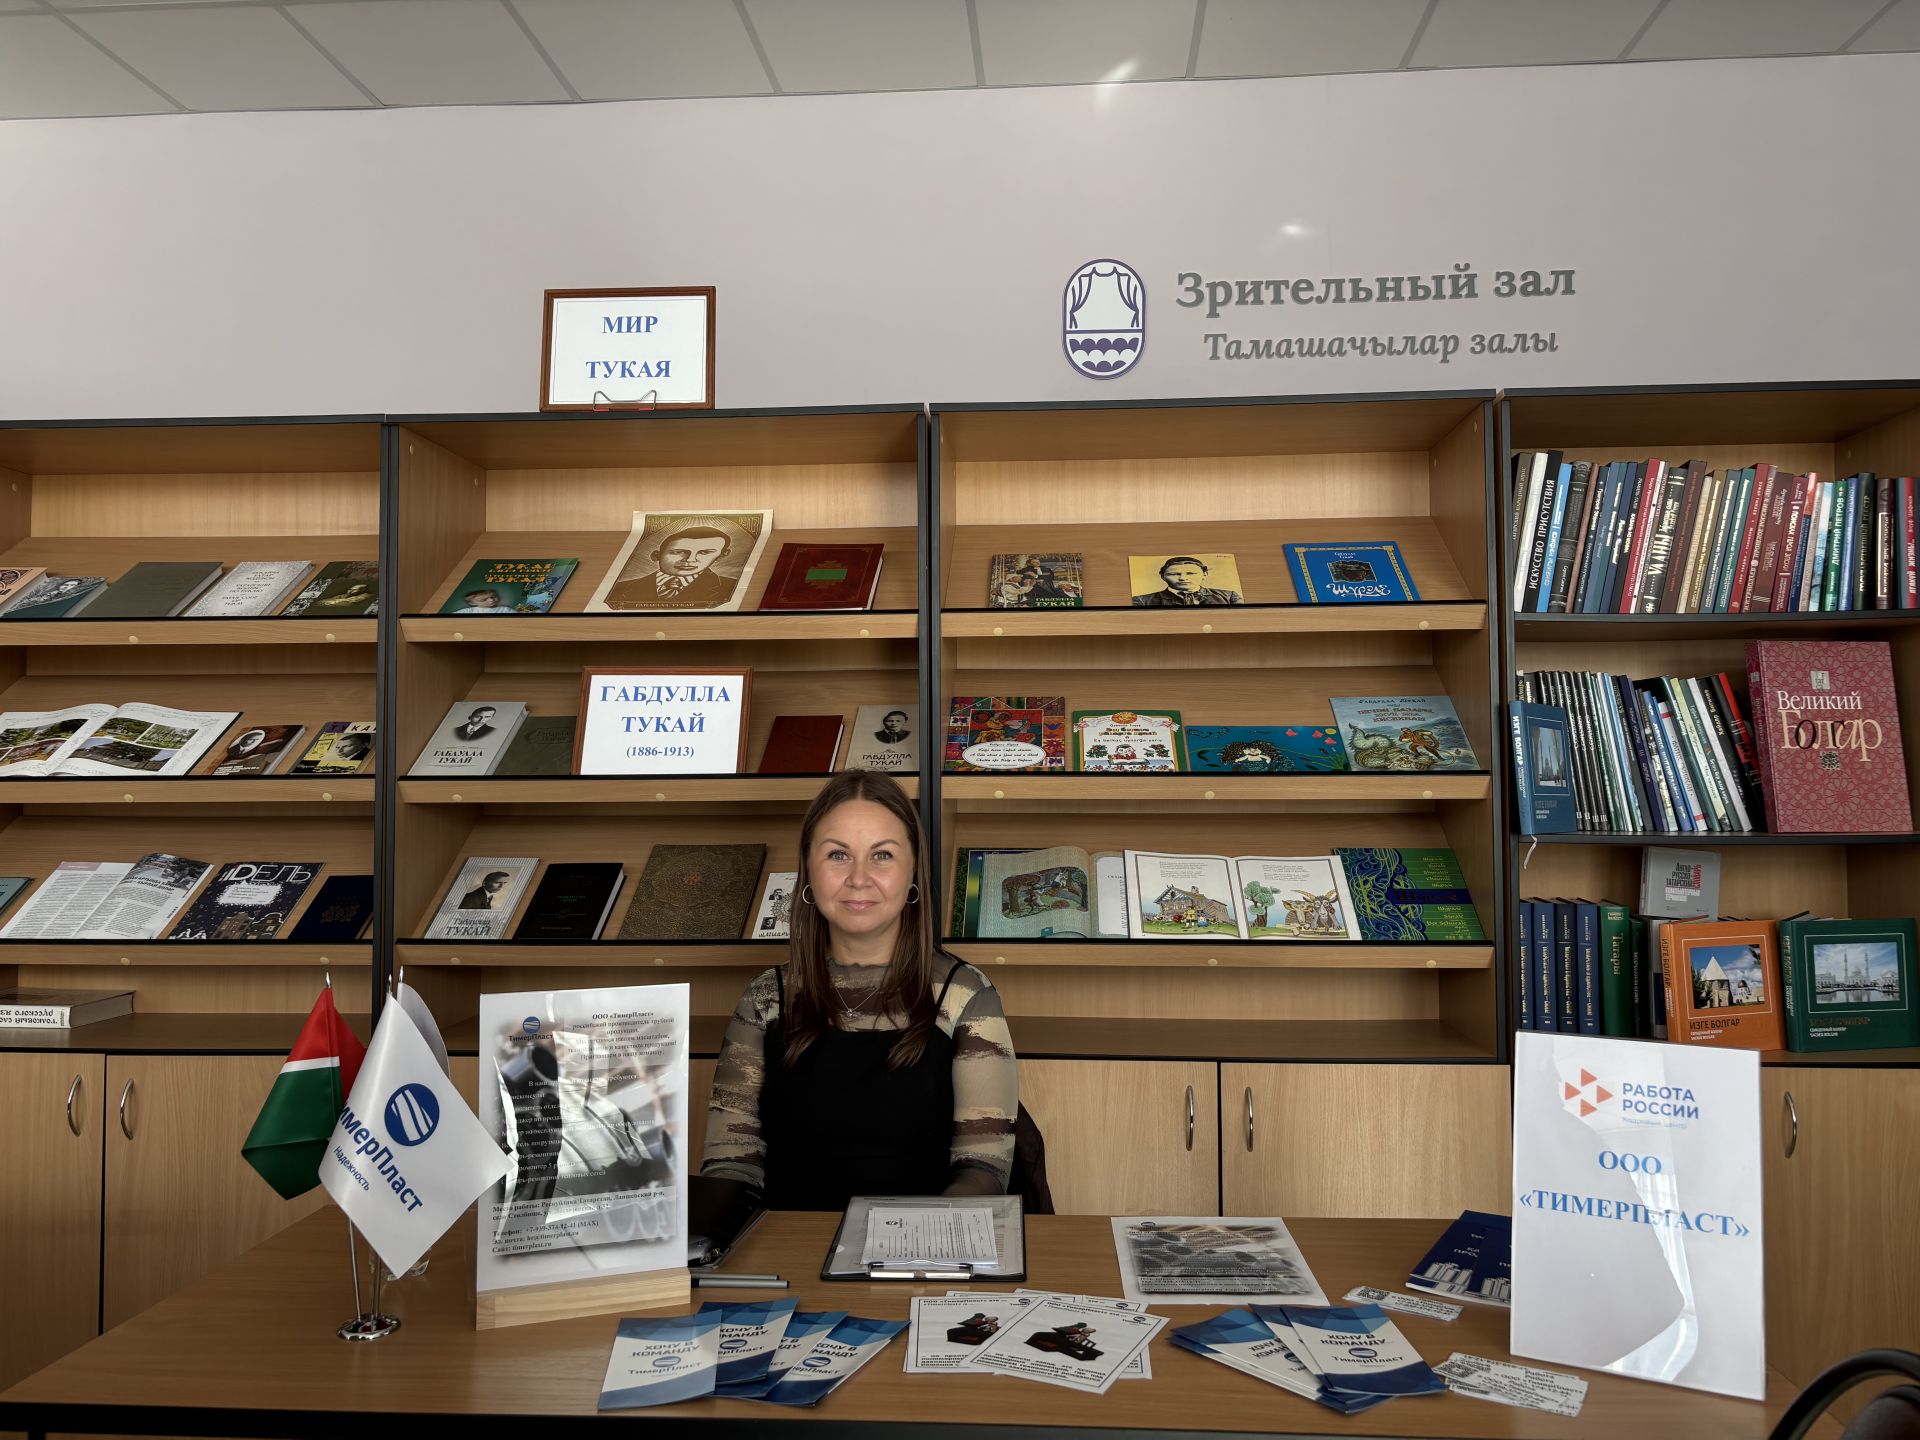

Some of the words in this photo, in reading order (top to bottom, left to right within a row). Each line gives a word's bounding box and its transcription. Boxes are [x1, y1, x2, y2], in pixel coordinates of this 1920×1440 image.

[1176, 262, 1479, 318] Зрительный
[1494, 269, 1576, 298] зал
[602, 315, 658, 334] МИР
[1204, 333, 1460, 364] Тамашачылар
[1469, 332, 1558, 355] залы
[586, 360, 672, 379] ТУКАЯ
[1535, 478, 1556, 537] ПРИСУТСТВИЯ
[1834, 496, 1845, 527] ПЕТРОВ
[1830, 528, 1843, 565] ДМИТРИЙ
[1526, 540, 1545, 589] ИСКУССТВО
[600, 686, 731, 706] ГАБДУЛЛА
[1776, 690, 1863, 710] Великий
[622, 712, 706, 733] ТУКАЙ
[1512, 715, 1520, 734] ИЗГЕ
[1777, 709, 1883, 762] Болгар
[626, 746, 695, 758] (1886-1913)
[862, 753, 913, 761] ГАБДУЛЛА
[1514, 736, 1523, 765] БОЛГАР
[446, 925, 491, 936] ТУКАЙ
[1607, 933, 1627, 976] Татары
[1660, 938, 1670, 957] ИЗГЕ
[1661, 958, 1672, 987] БОЛГАР
[592, 1013, 608, 1021] ООО
[1690, 1021, 1710, 1030] ИЗГЕ
[1710, 1018, 1740, 1029] БОЛГАР
[1622, 1082, 1695, 1102] РАБОТА
[1622, 1099, 1699, 1120] РОССИИ
[334, 1146, 371, 1192] Надежность
[339, 1105, 423, 1213] имерПласт
[1598, 1150, 1662, 1176] ООО
[514, 1203, 540, 1212] работы:
[1519, 1188, 1750, 1238] «ТИМЕРПЛАСТ»
[644, 1342, 680, 1352] ХОЧУ
[1320, 1337, 1388, 1347] КОМАНДУ
[1326, 1333, 1364, 1341] ХОЧУ
[631, 1344, 701, 1358] КОМАНДУ
[1331, 1354, 1404, 1364] ТимерПласт
[627, 1360, 703, 1376] ТимерПласт
